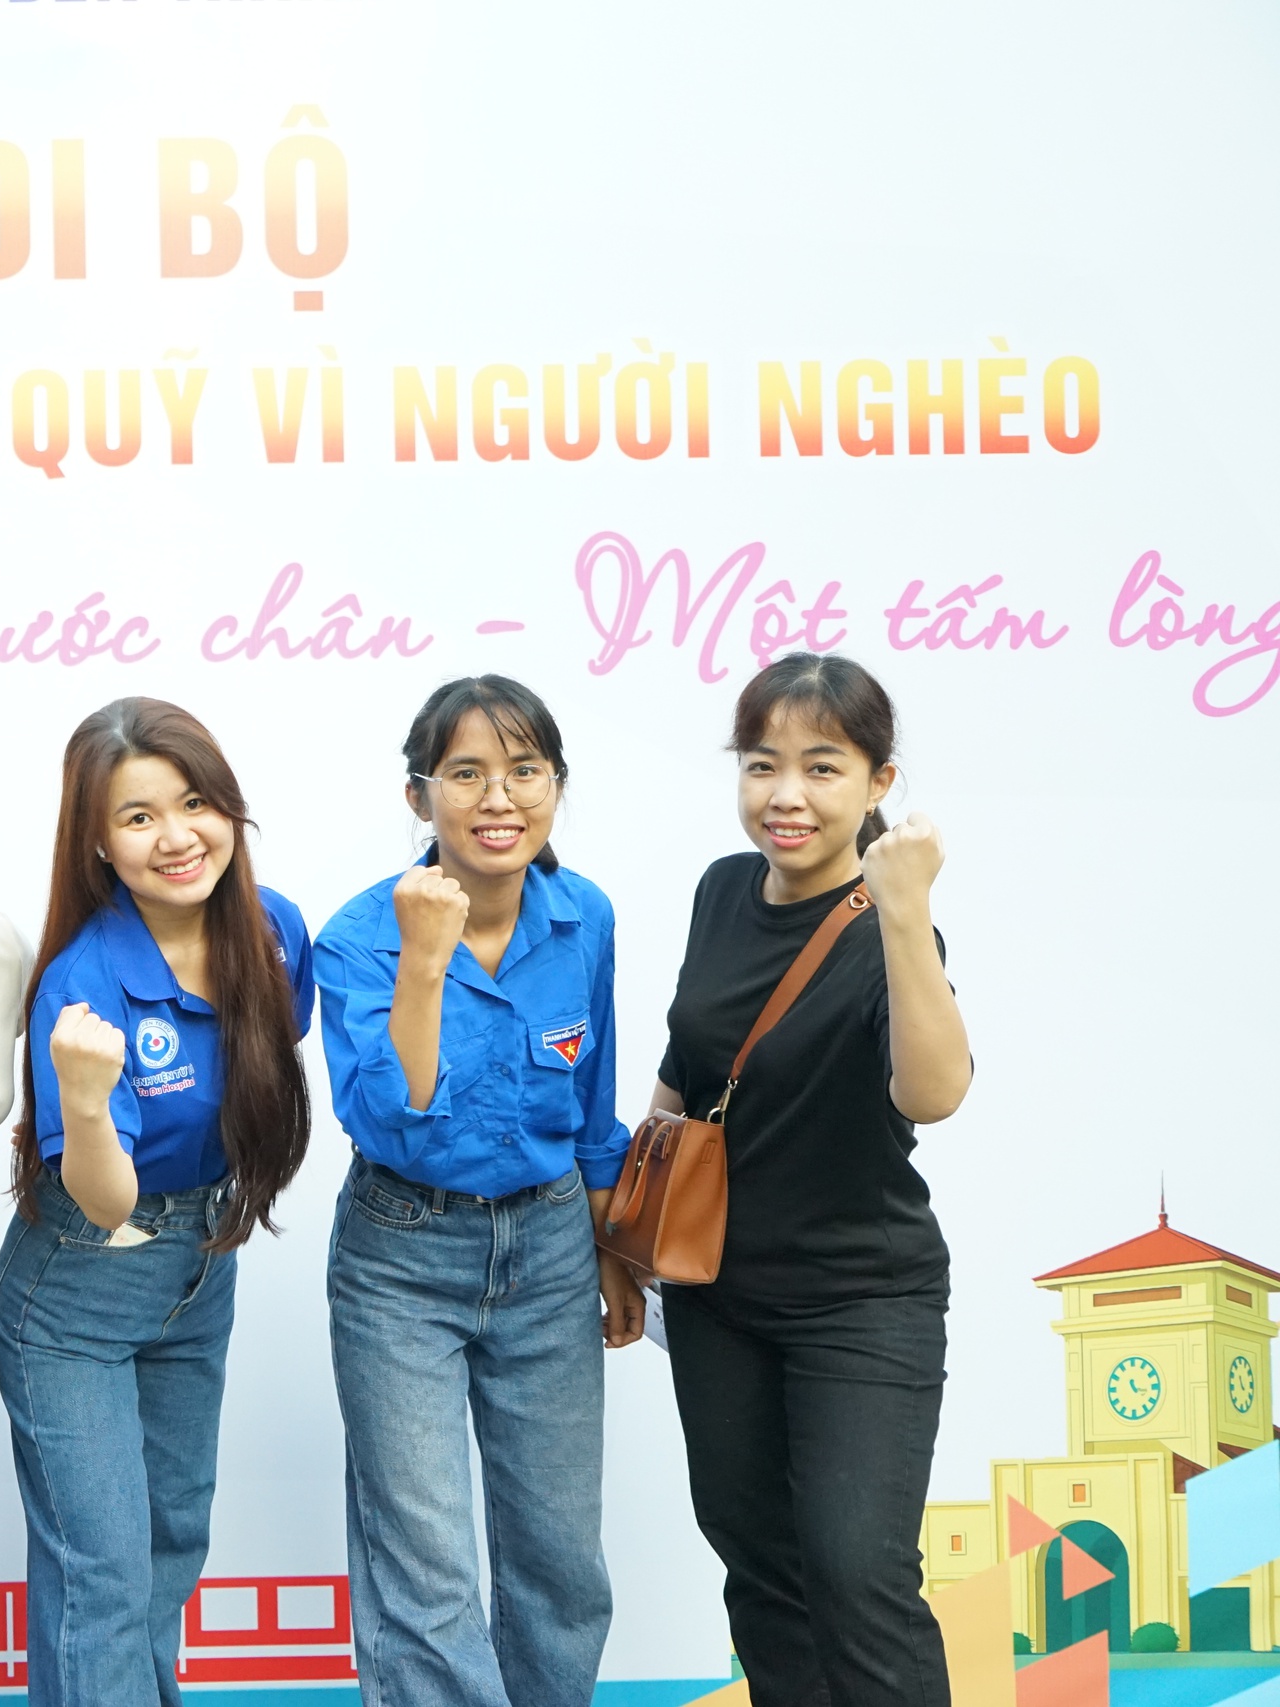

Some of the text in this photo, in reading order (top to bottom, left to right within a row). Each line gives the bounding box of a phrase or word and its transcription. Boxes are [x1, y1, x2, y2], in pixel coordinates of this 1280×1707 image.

[157, 102, 351, 312] BỘ
[10, 347, 210, 481] QUỸ
[251, 344, 346, 465] VÌ
[392, 337, 712, 464] NGƯỜI
[757, 335, 1102, 459] NGHÈO
[200, 561, 435, 663] chân
[574, 530, 850, 685] Một
[882, 573, 1071, 652] tấm
[161, 1078, 196, 1094] Hospita
